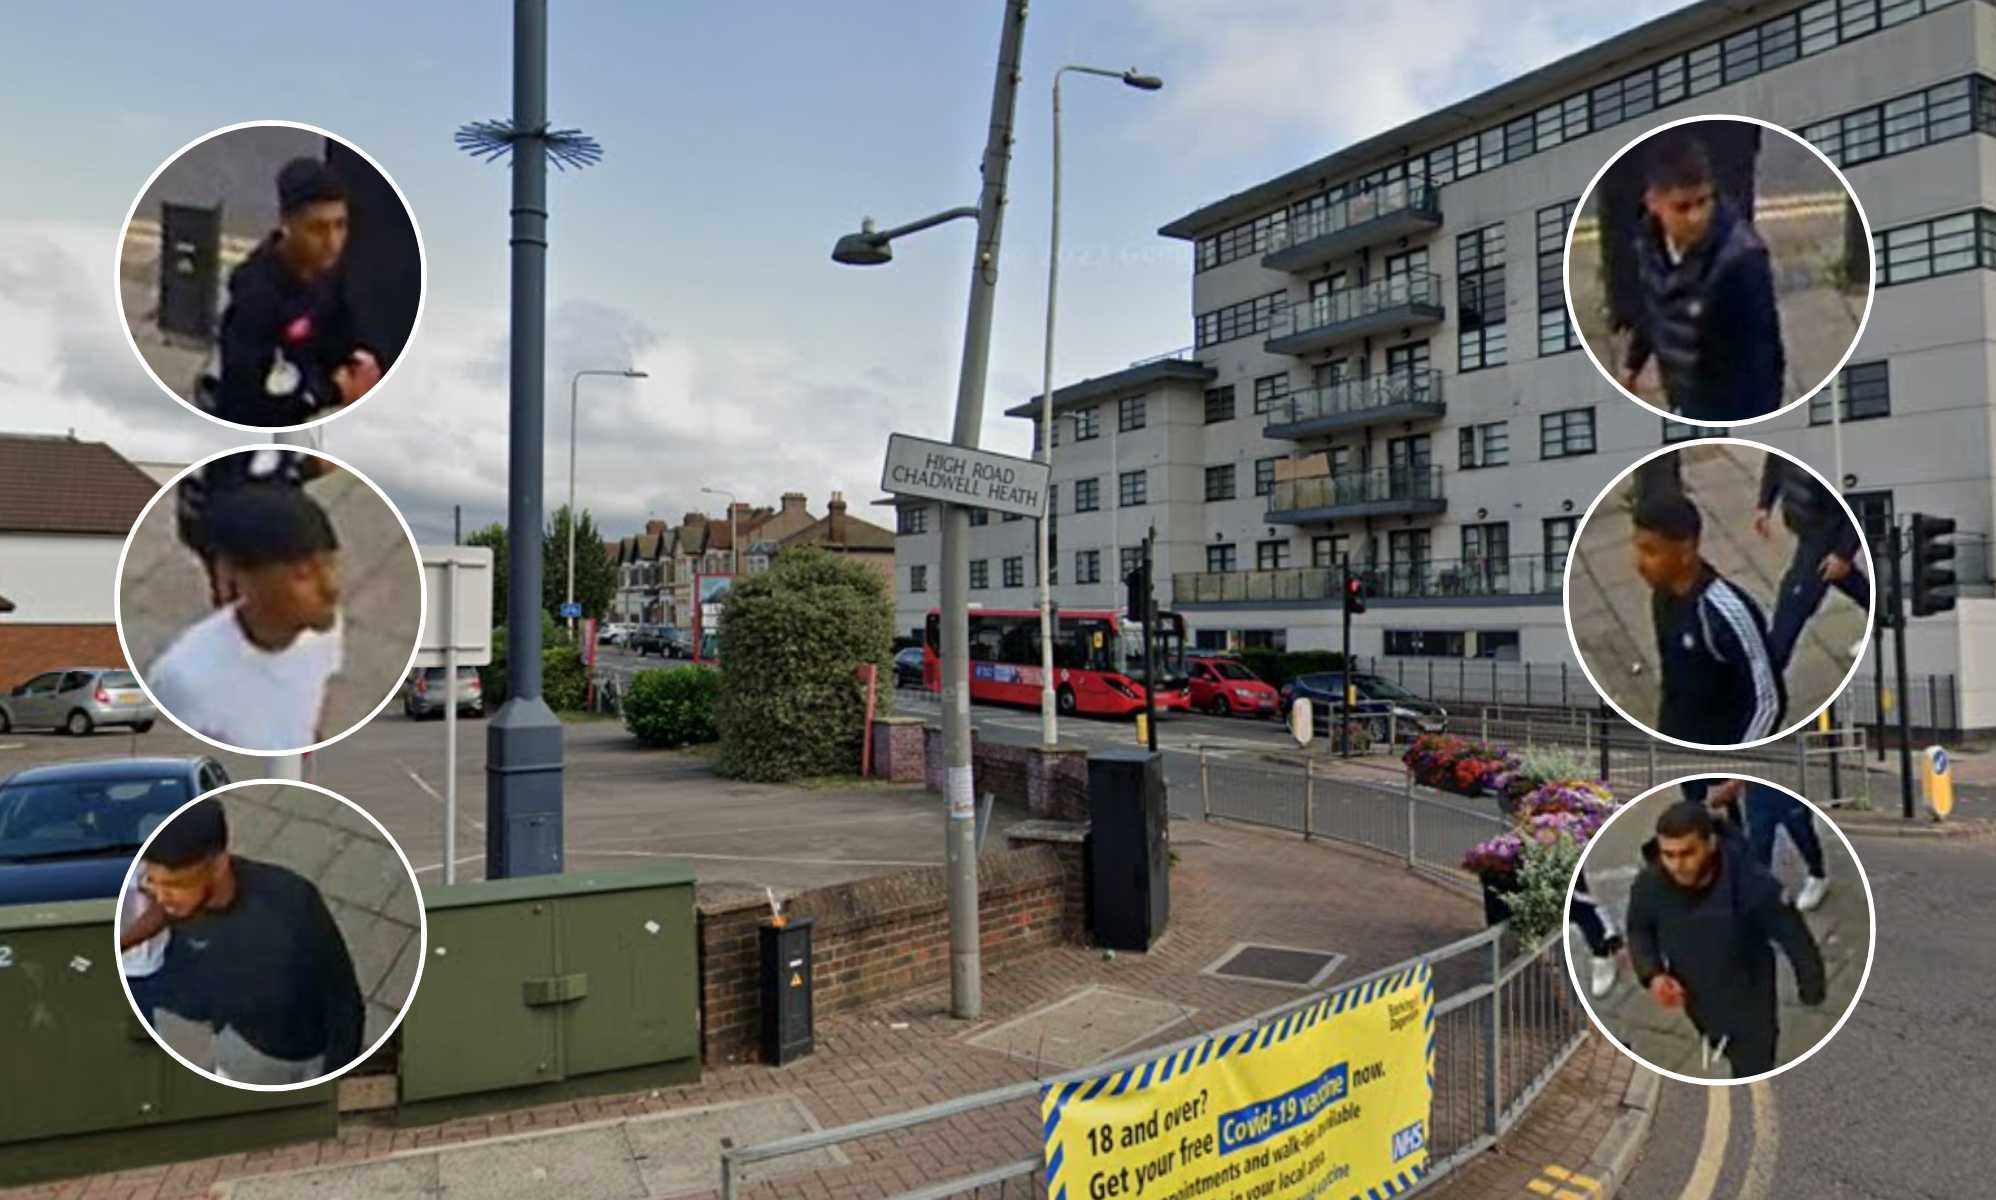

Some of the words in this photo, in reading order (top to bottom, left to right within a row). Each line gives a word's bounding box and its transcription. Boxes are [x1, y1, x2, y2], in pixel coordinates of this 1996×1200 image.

[892, 465, 980, 496] CHADWELL
[988, 483, 1038, 507] HEATH
[925, 452, 967, 475] HIGH
[972, 462, 1015, 484] ROAD
[1087, 1123, 1114, 1157] 18
[1120, 1108, 1159, 1149] and
[1163, 1088, 1208, 1132] over?
[1089, 1165, 1130, 1200] Get
[1135, 1150, 1175, 1197] your
[1178, 1132, 1213, 1167] free
[1222, 1096, 1298, 1146] Covid-19
[1299, 1074, 1345, 1117] vaccine
[1352, 1060, 1386, 1088] now.
[1392, 1121, 1424, 1160] NHS
[1243, 1147, 1270, 1174] and
[1246, 1178, 1277, 1200] your
[1278, 1159, 1306, 1192] local
